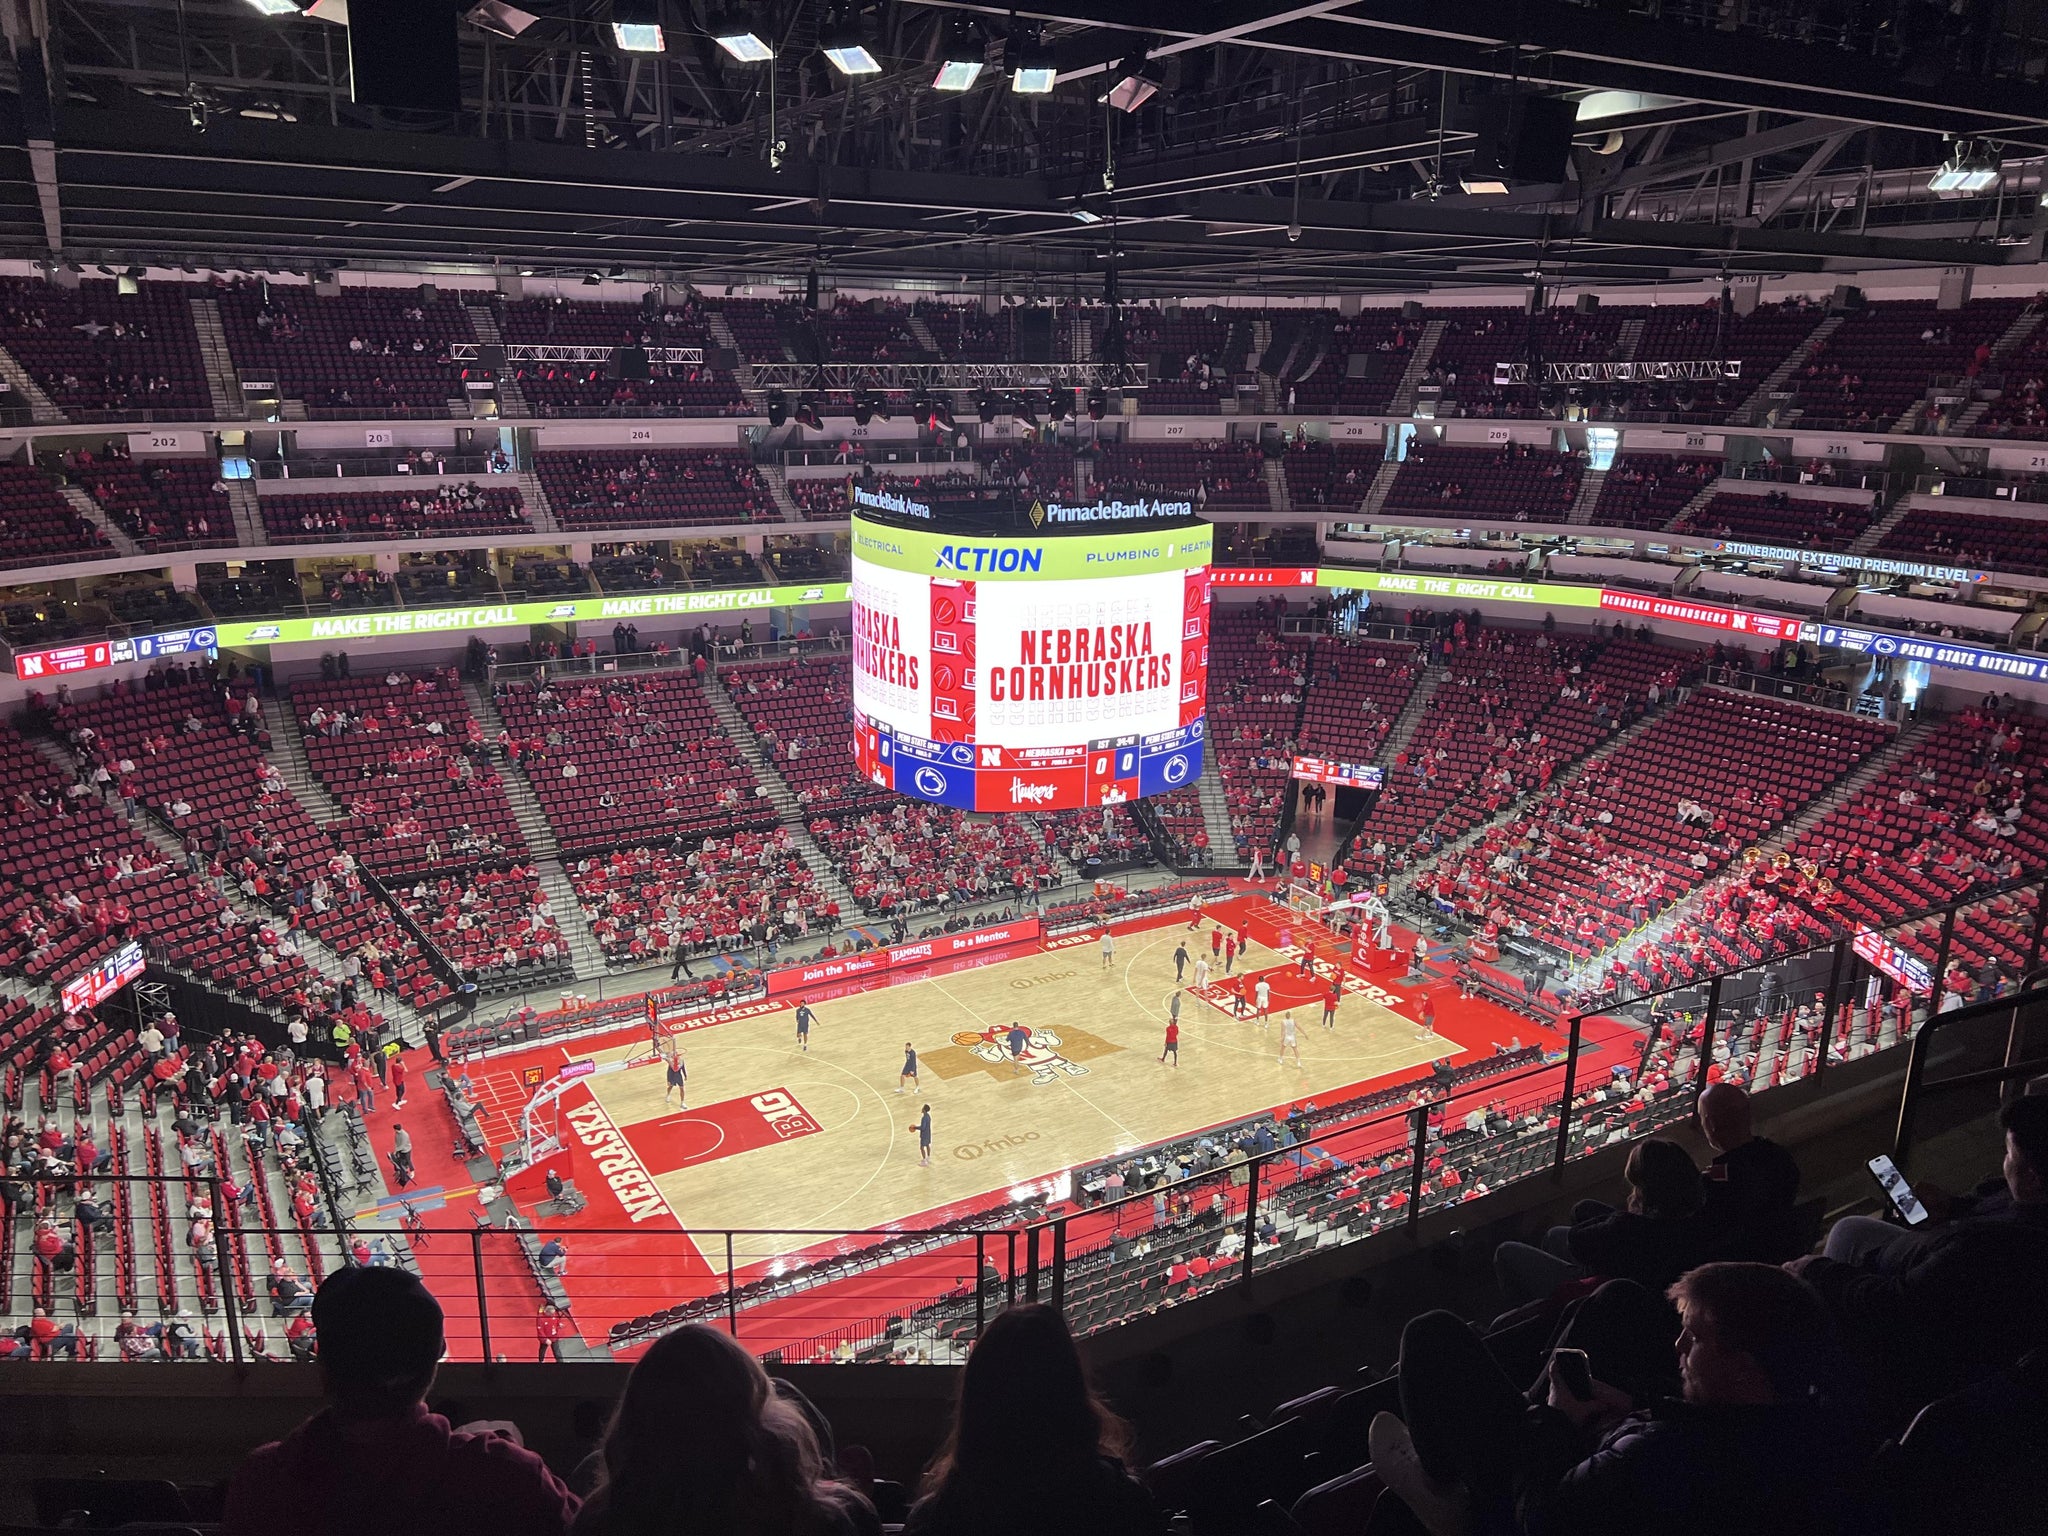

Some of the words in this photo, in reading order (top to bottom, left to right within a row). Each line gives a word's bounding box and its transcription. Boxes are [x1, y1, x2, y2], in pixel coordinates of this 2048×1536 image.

[368, 434, 391, 443] 203
[632, 431, 650, 440] 204
[852, 428, 868, 436] 205
[1489, 431, 1508, 439] 209
[152, 438, 177, 447] 202
[1687, 438, 1704, 446] 210
[1828, 445, 1848, 454] 211
[2031, 457, 2048, 466] 21
[854, 486, 906, 514] PinnacleBank
[905, 498, 930, 519] Arena
[1047, 498, 1149, 523] PinnacleBank
[1150, 499, 1192, 517] Arena
[858, 535, 904, 556] ELECTRICAL
[934, 545, 1044, 572] ACTION
[1086, 548, 1160, 563] PLUMBING
[1725, 541, 1800, 562] STONEBROOK
[1801, 550, 1862, 570] EXTERIOR
[1864, 558, 1925, 577] PREMIUM
[1927, 566, 1971, 583] LEVEL
[1300, 571, 1313, 584] N
[1378, 576, 1419, 590] MAKE
[1423, 579, 1451, 593] THE
[1455, 582, 1500, 597] RIGHT
[1501, 585, 1535, 599] CALL
[601, 598, 652, 616] MAKE
[653, 595, 687, 612] THE
[688, 592, 740, 610] RIGHT
[740, 590, 775, 606] CALL
[1602, 594, 1650, 612] NEBRASKA
[1653, 602, 1728, 625] CORNHUSKERS
[311, 617, 370, 637] MAKE
[373, 614, 412, 632] THE
[414, 610, 473, 629] RIGHT
[473, 607, 518, 625] CALL
[1731, 613, 1747, 630] N
[1785, 623, 1796, 636] 0
[158, 635, 163, 643] 4
[1020, 621, 1152, 665] NEBRASKA
[1824, 629, 1836, 643] 0
[94, 647, 105, 662] 0
[141, 639, 152, 655] 0
[166, 643, 184, 653] FOULS
[1846, 641, 1864, 651] FOULS
[22, 655, 44, 676] N
[66, 660, 86, 670] FOULS
[1899, 642, 1934, 659] PENN
[1935, 648, 1977, 667] STATE
[1978, 655, 2038, 676] NITTANY
[990, 653, 1171, 702] CORNHUSKERS
[869, 734, 876, 751] 0
[881, 740, 890, 758] 0
[911, 737, 927, 748] STATE
[981, 747, 1002, 767] N
[1025, 748, 1065, 757] NEBRASKA
[1095, 757, 1108, 775] 0
[1121, 753, 1134, 771] 0
[1327, 767, 1334, 775] 0
[1342, 769, 1349, 777] 0
[1009, 776, 1058, 805] Huskers
[952, 939, 966, 950] Be
[967, 938, 974, 946] a
[975, 930, 1011, 944] Mentor.
[1046, 934, 1095, 949] #GBR
[890, 943, 932, 963] TEAMMATES
[802, 970, 824, 982] Join
[825, 965, 843, 978] the
[1034, 970, 1078, 985] fnbo
[669, 1001, 784, 1031] @HUSKERS
[561, 1062, 594, 1078] TEAMMATES
[750, 1092, 817, 1139] BIG
[983, 1131, 1041, 1152] fnbo
[565, 1101, 670, 1223] NEBRASKA
